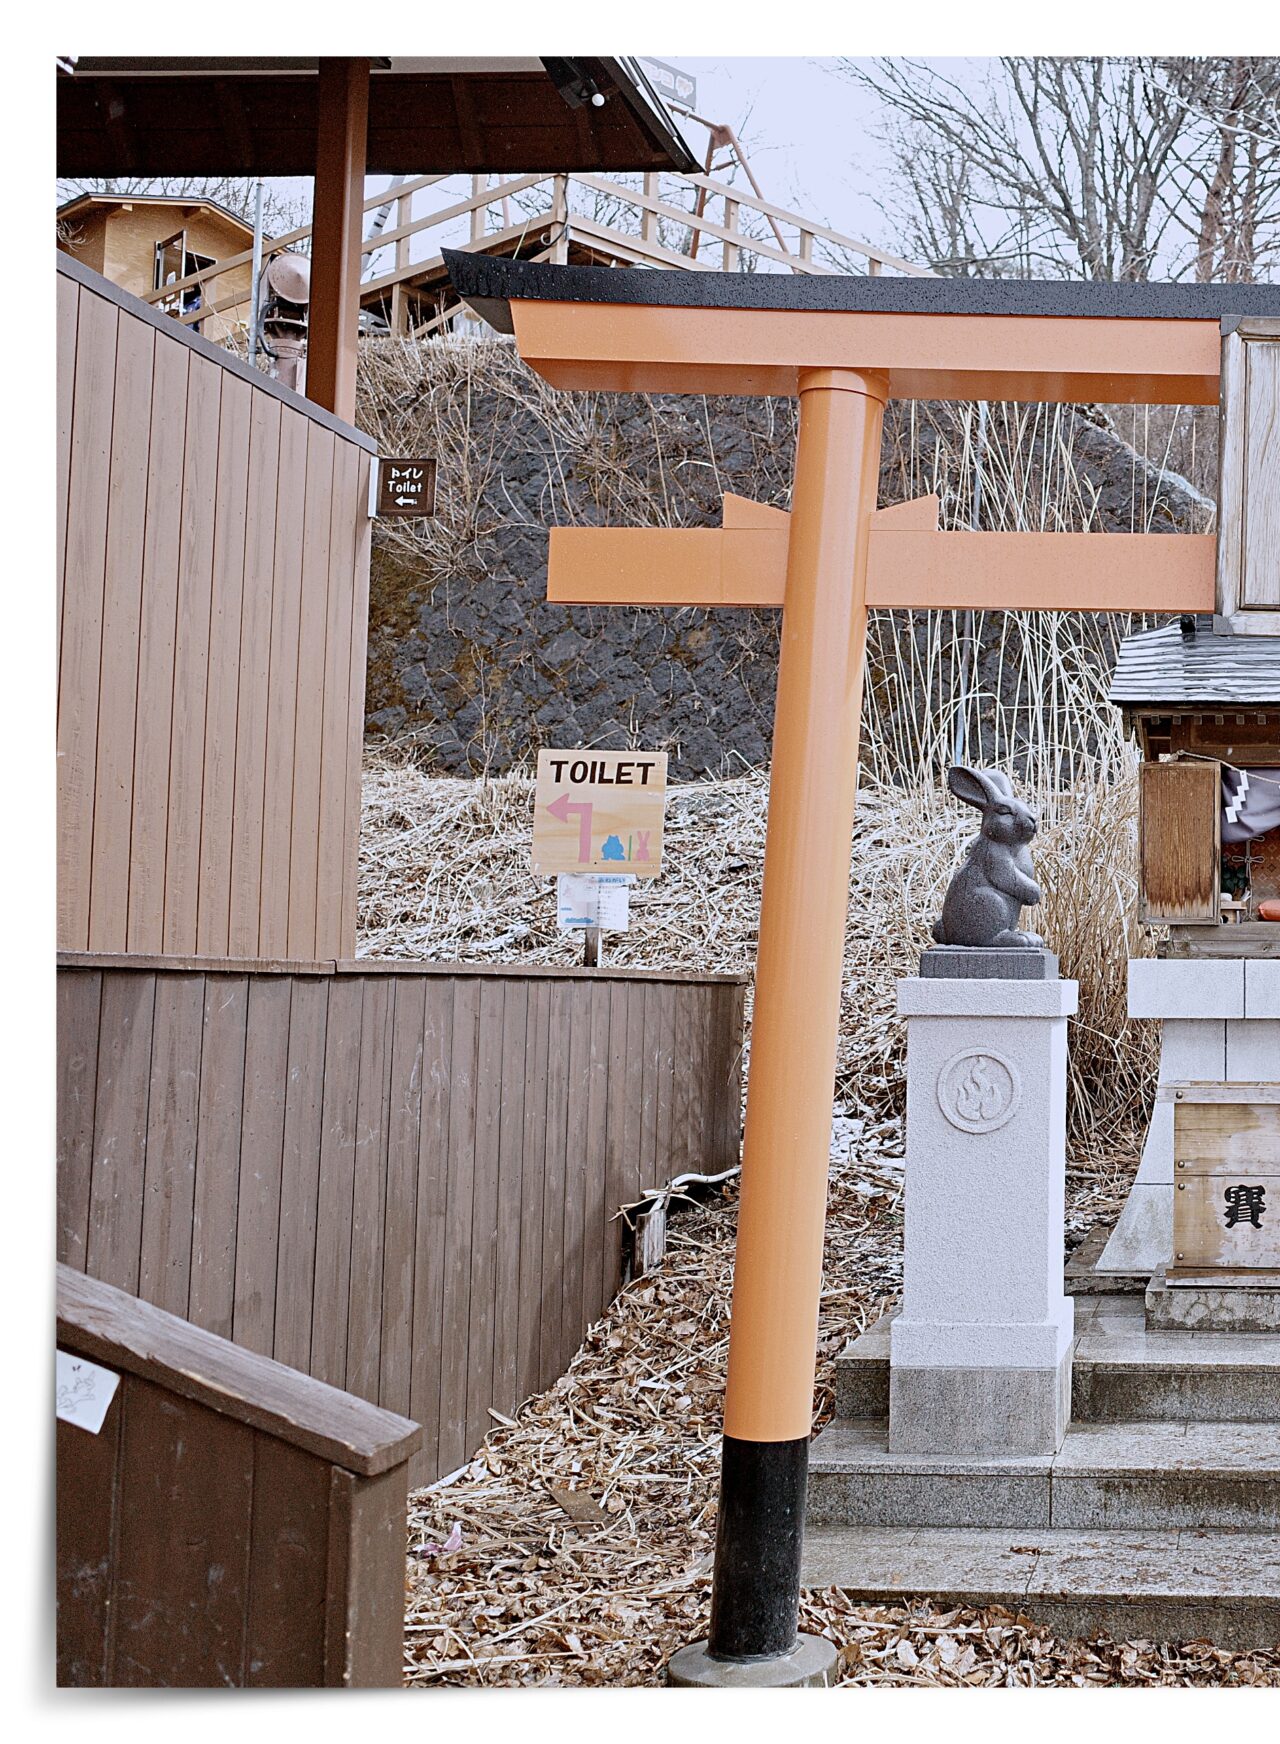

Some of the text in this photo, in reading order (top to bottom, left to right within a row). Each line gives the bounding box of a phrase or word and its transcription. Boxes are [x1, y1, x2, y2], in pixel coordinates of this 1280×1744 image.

[391, 467, 423, 479] トイレ
[387, 480, 423, 493] Toilet
[549, 760, 655, 785] TOILET
